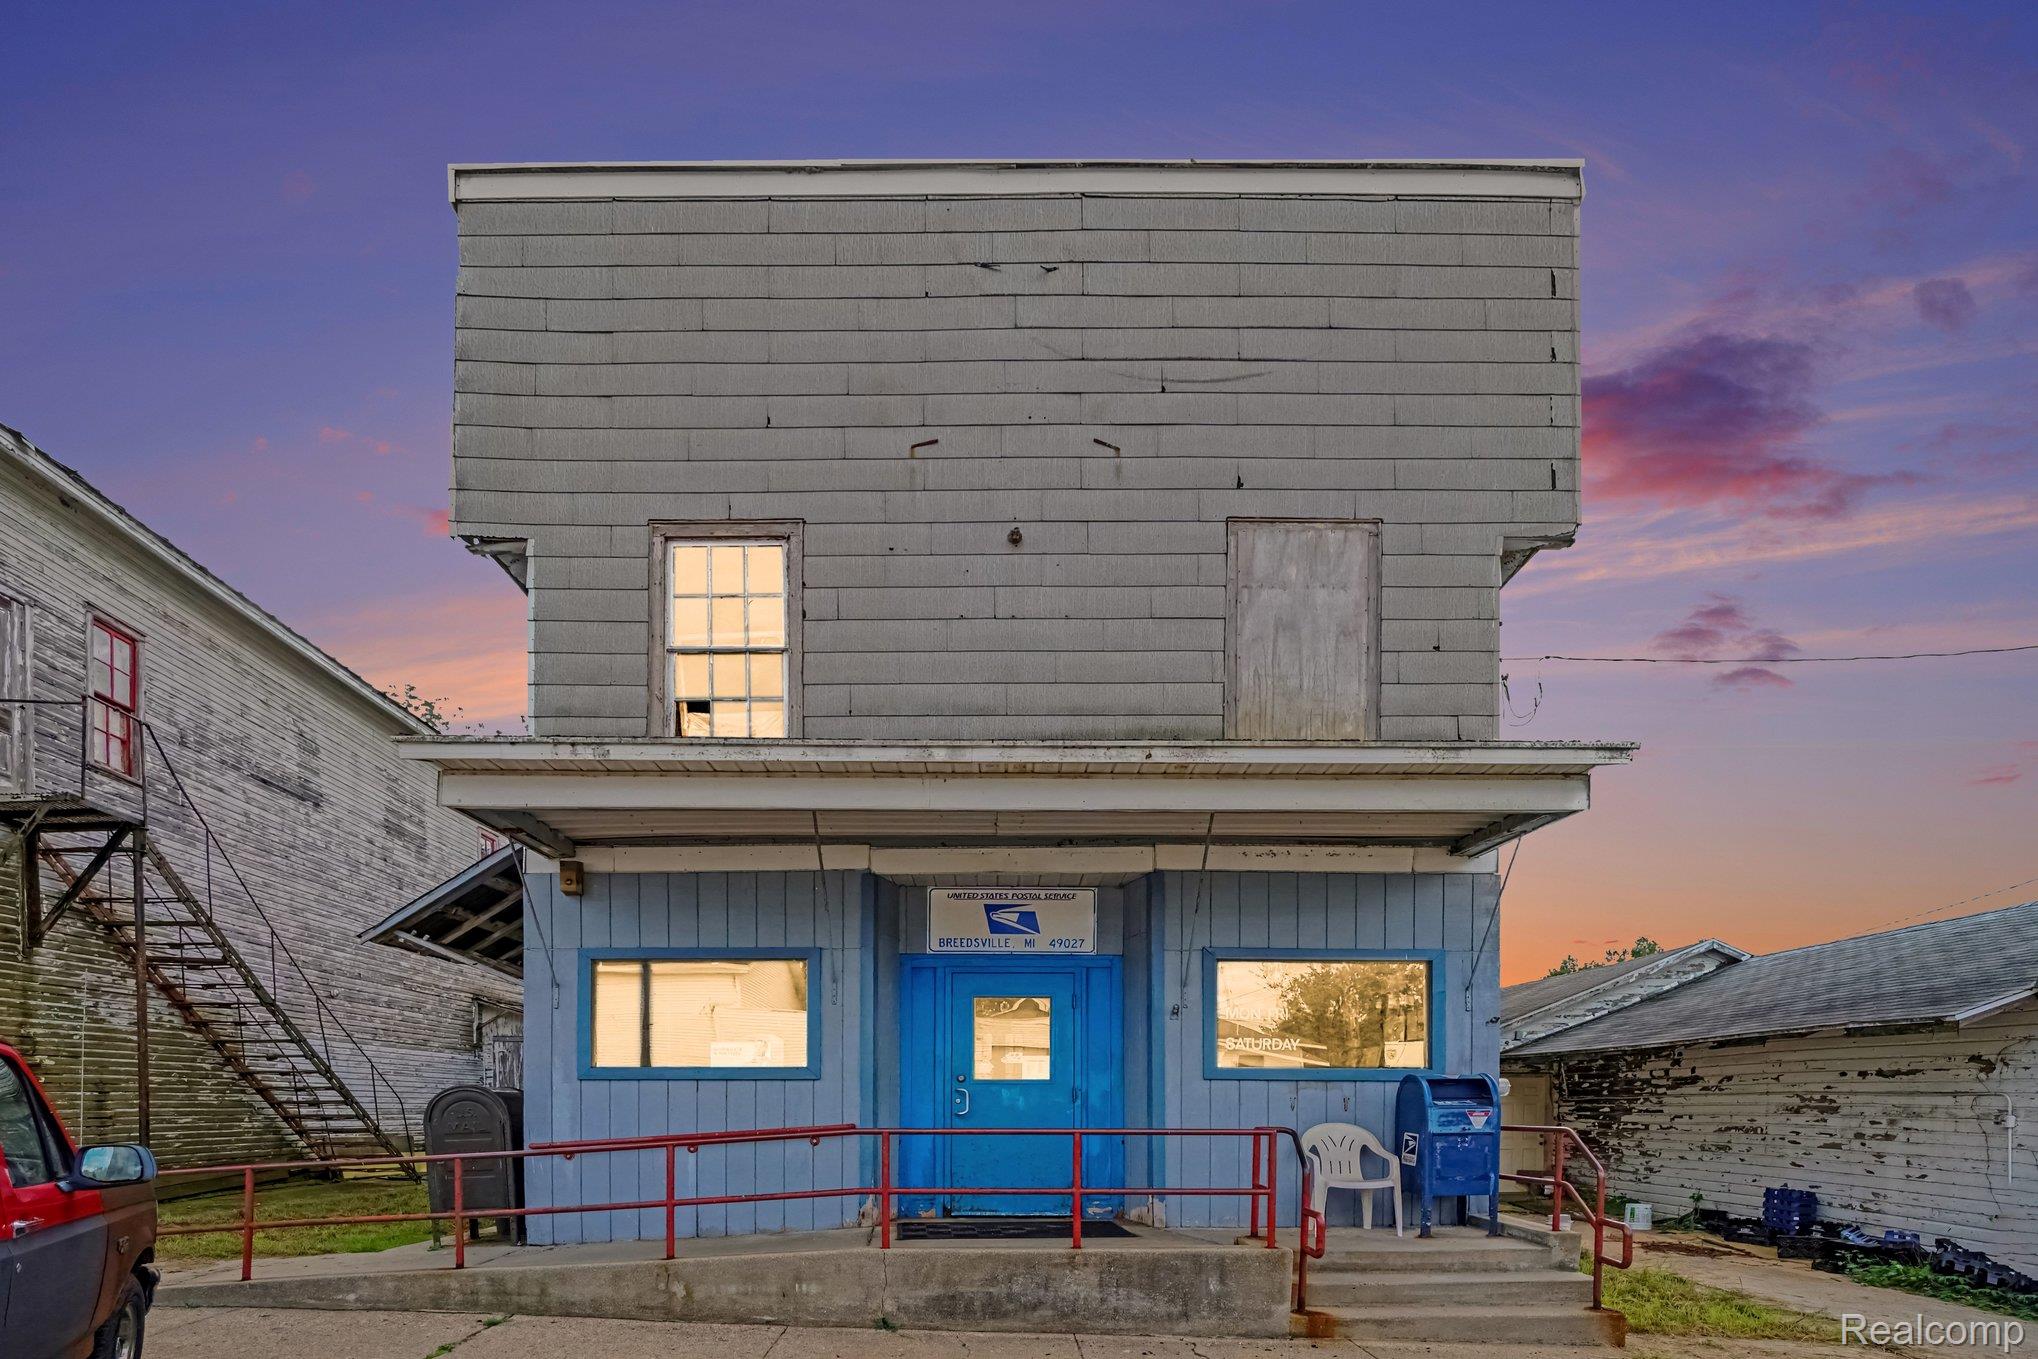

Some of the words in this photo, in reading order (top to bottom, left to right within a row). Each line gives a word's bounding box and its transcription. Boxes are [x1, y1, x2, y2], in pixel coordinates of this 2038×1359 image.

[947, 892, 979, 900] UNITED
[980, 892, 1009, 900] STATES
[1010, 892, 1041, 900] POSTAL
[1043, 892, 1077, 900] SERVICE
[1024, 938, 1036, 948] MI
[1048, 938, 1085, 948] 49027
[1225, 1037, 1300, 1051] SATURDAY
